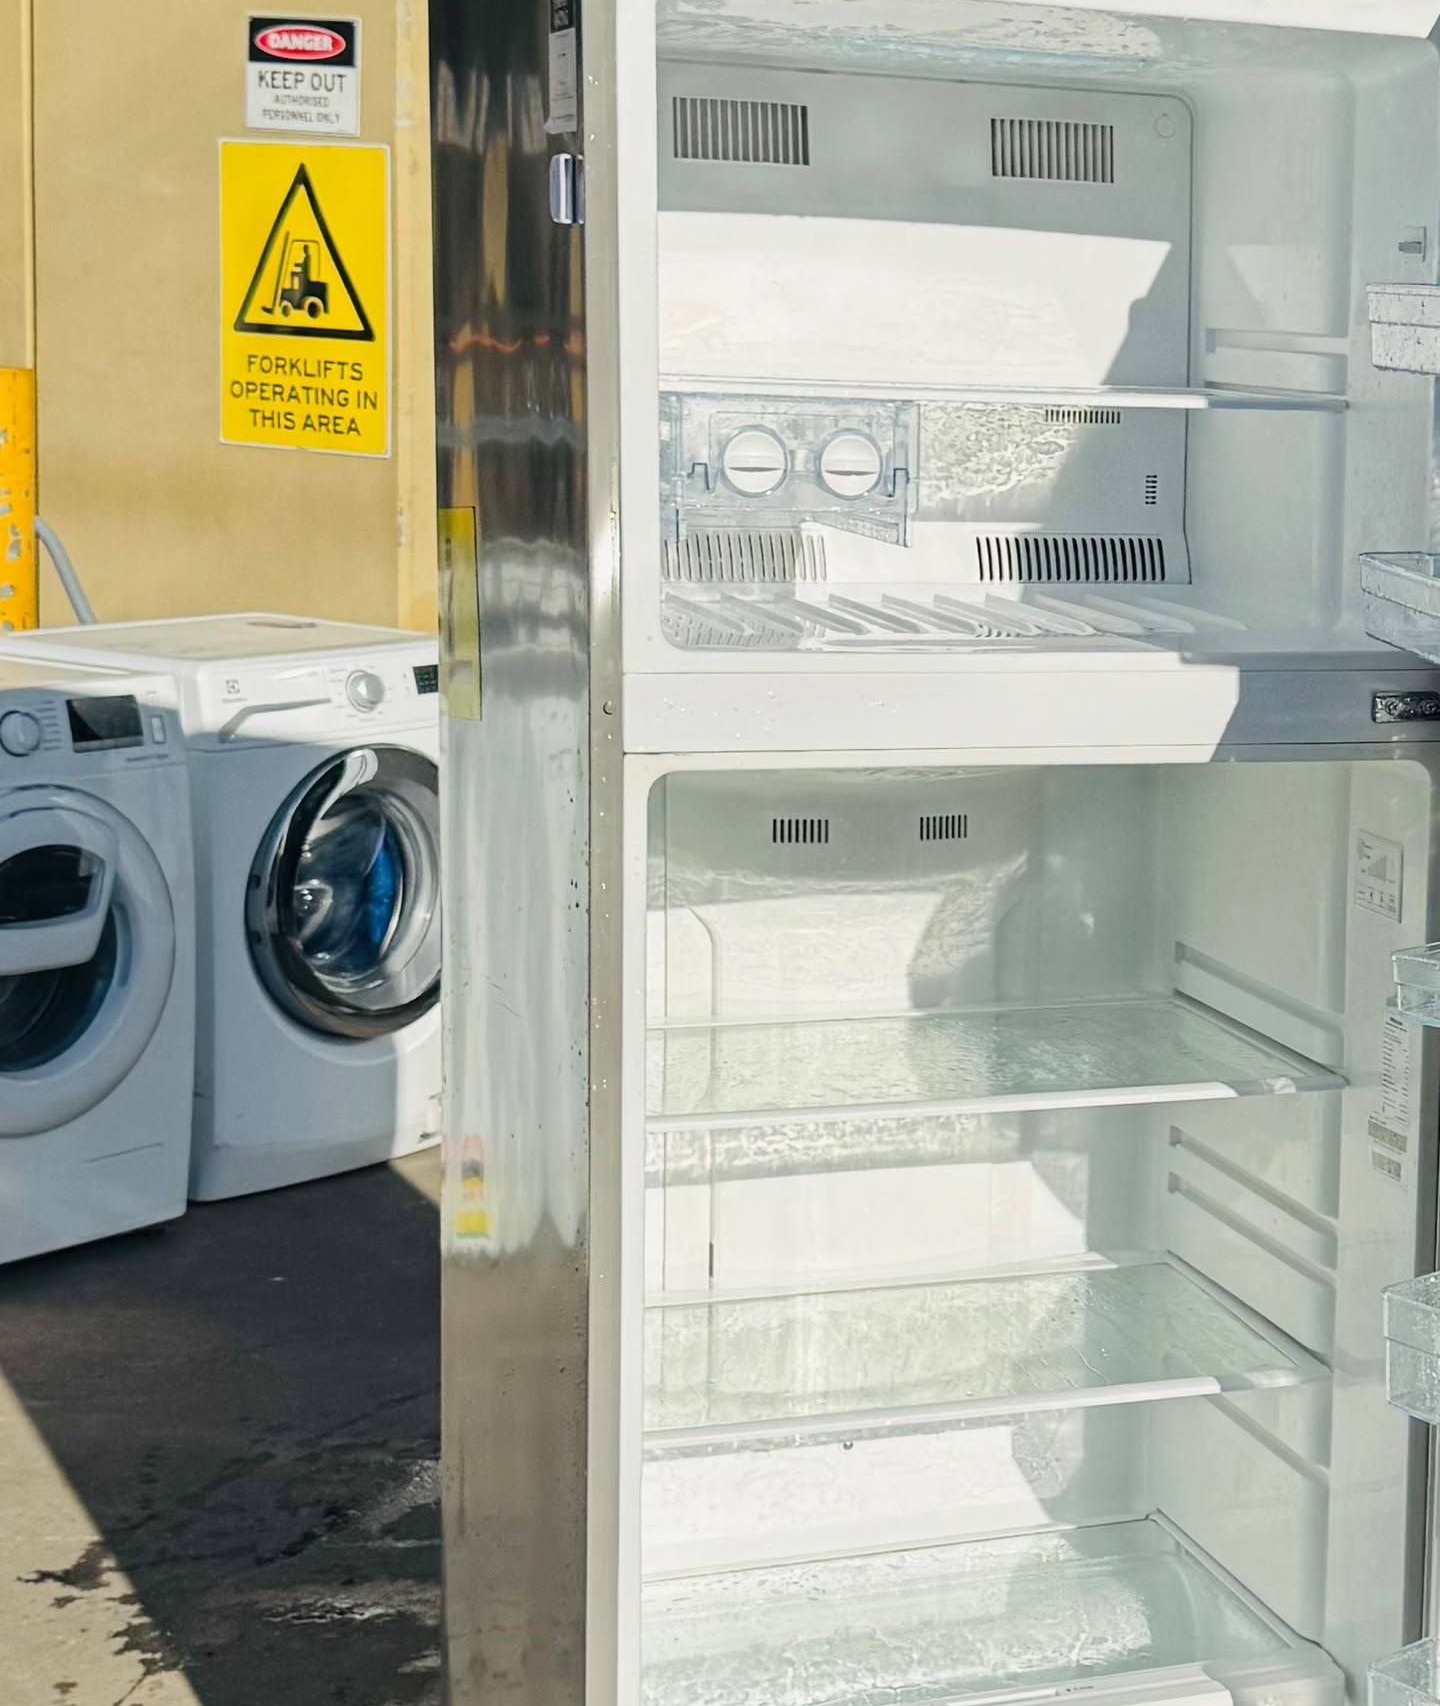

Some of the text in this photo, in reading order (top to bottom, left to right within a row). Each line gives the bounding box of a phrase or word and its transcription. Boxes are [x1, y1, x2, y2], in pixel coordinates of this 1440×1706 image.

[267, 31, 333, 52] DANGER
[258, 70, 347, 93] KEEP OUT
[262, 108, 341, 125] PERSONNEL ONLY
[247, 354, 363, 382] FORKLIFTS
[230, 380, 378, 410] OPERATING IN
[249, 408, 362, 437] THIS AREA
